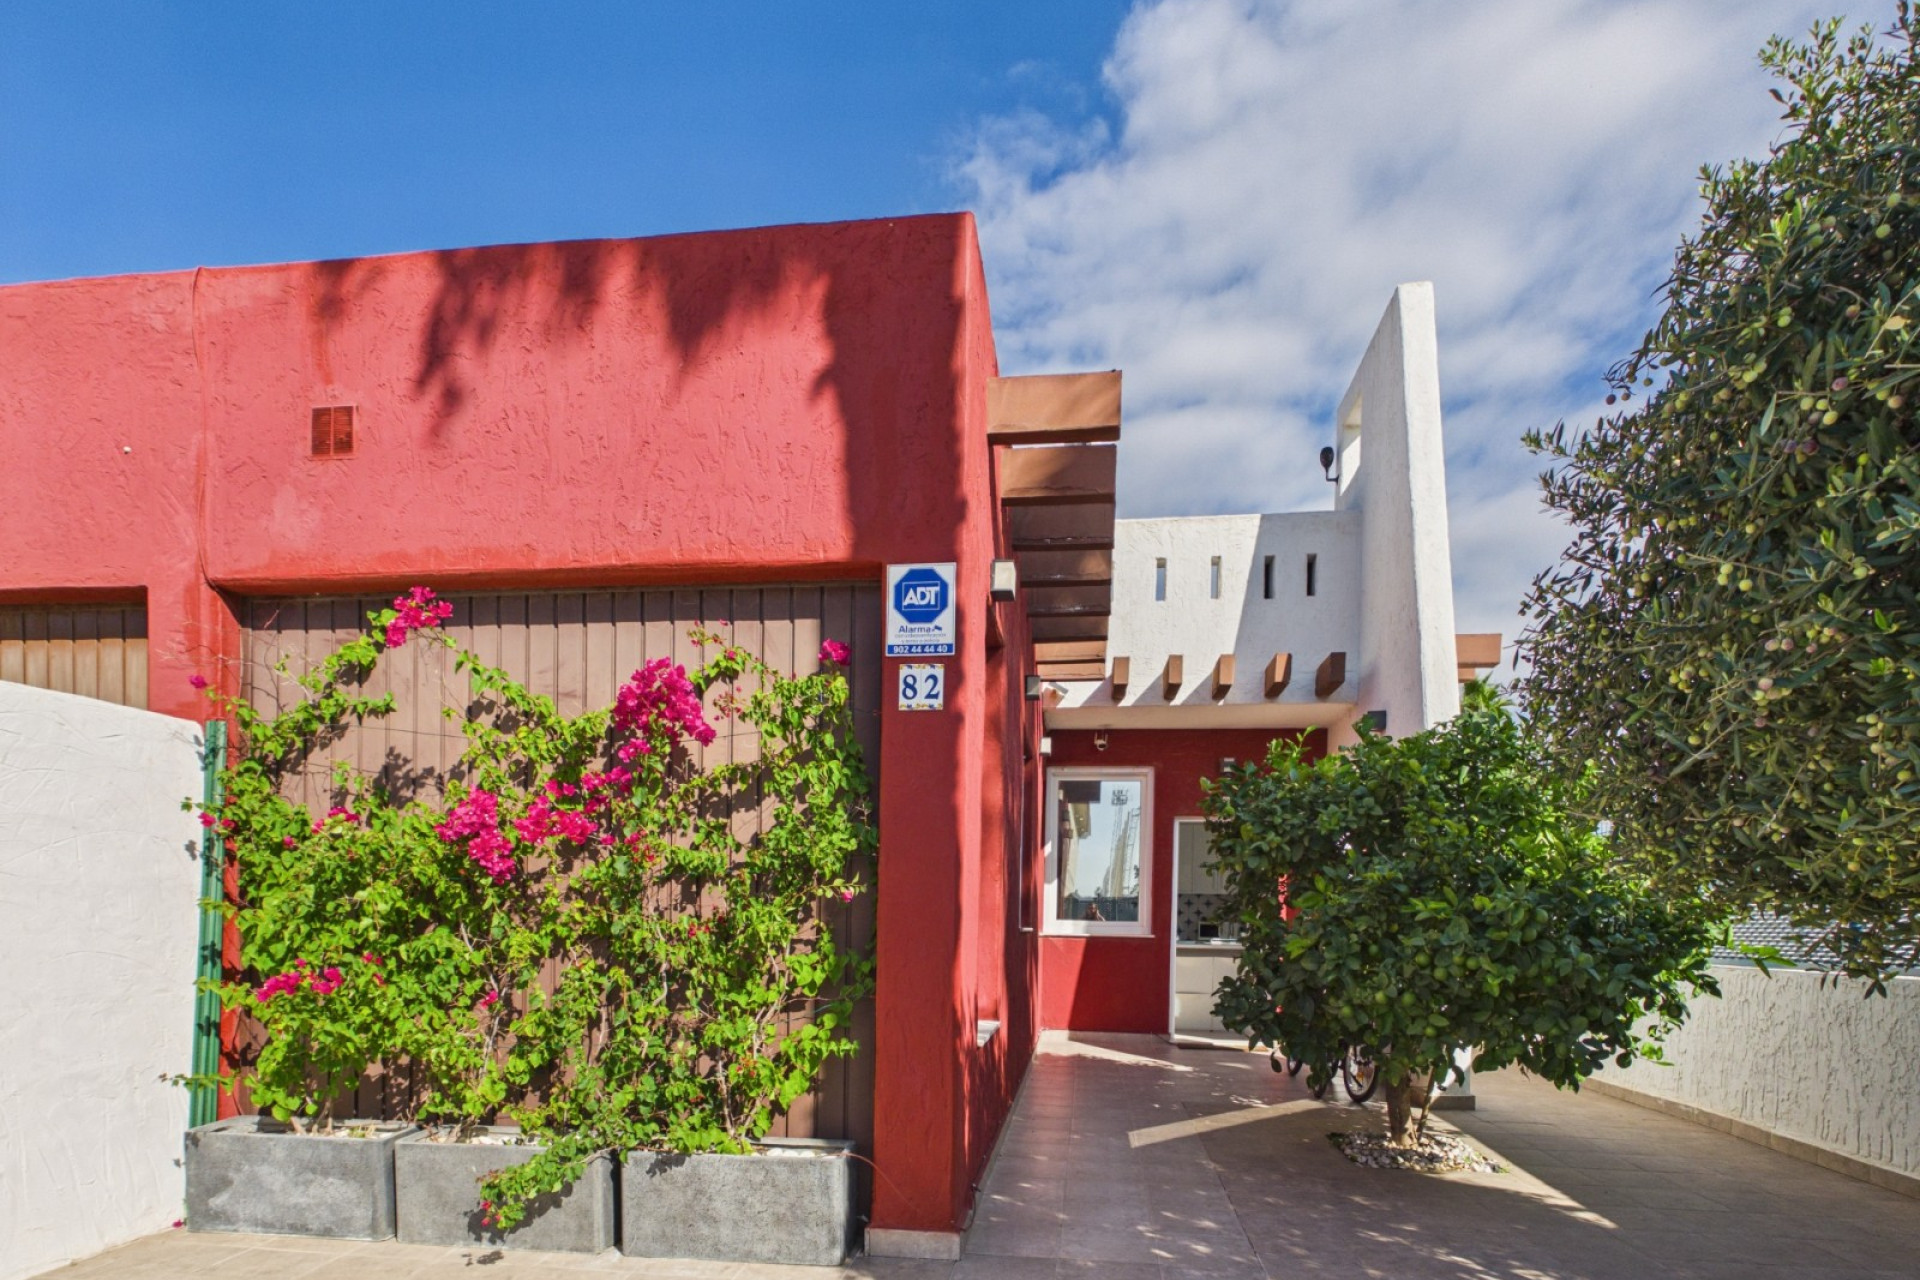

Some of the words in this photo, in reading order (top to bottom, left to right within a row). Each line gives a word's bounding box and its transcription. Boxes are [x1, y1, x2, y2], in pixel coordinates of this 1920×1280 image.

[903, 586, 940, 606] ADT
[899, 625, 932, 633] Alarma
[893, 645, 909, 653] 902
[911, 645, 922, 653] 44
[924, 645, 935, 653] 44
[936, 644, 948, 653] 40
[902, 674, 940, 700] 82
